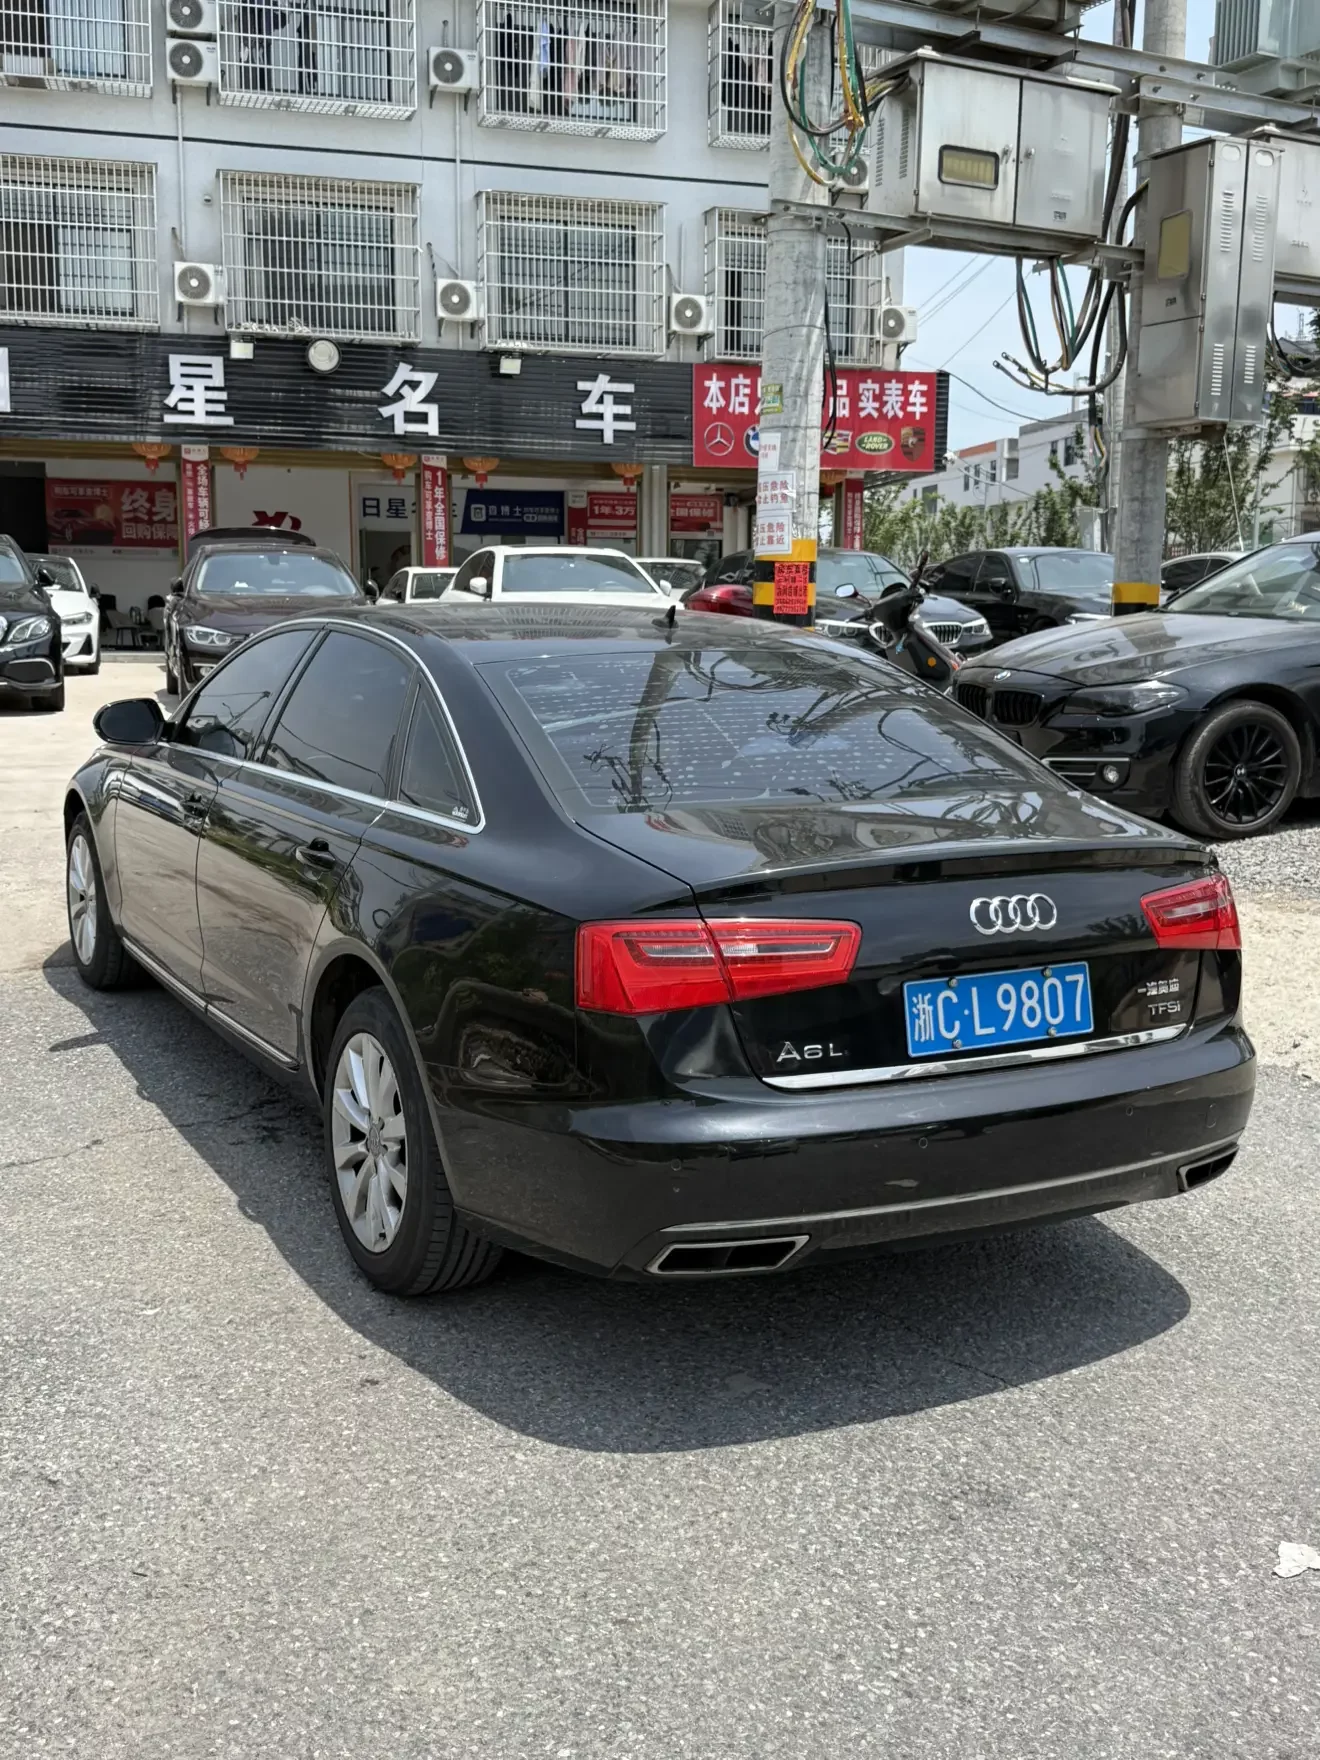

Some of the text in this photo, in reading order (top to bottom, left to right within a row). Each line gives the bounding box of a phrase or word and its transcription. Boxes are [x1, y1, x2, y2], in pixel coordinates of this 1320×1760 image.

[121, 487, 177, 522] 终身
[757, 522, 785, 534] 压危险
[911, 973, 1086, 1044] 浙C·L9807
[776, 1041, 843, 1062] A6L
